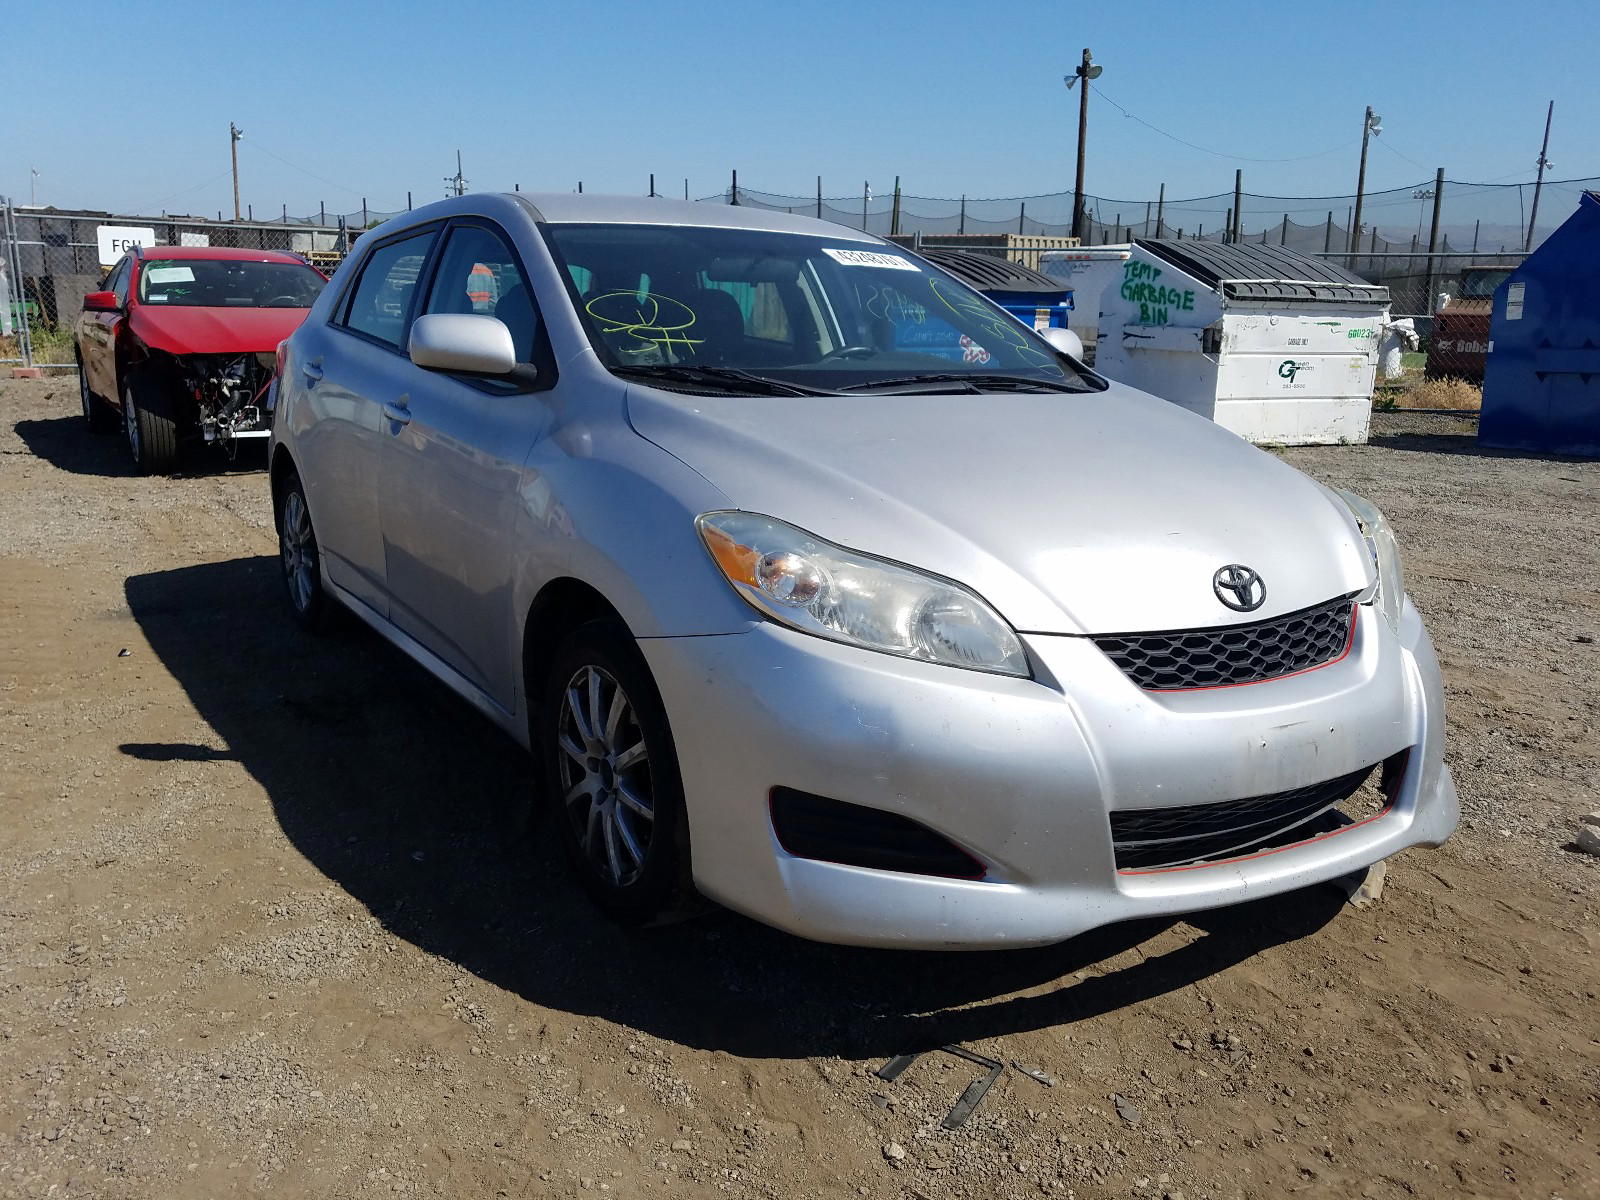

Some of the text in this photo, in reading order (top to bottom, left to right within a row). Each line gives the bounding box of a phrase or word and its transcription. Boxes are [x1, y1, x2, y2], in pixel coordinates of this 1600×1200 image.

[1123, 260, 1162, 281] TEMP
[1121, 278, 1195, 311] GARBAGE
[1139, 302, 1168, 324] BIN
[1456, 340, 1488, 353] Bobc
